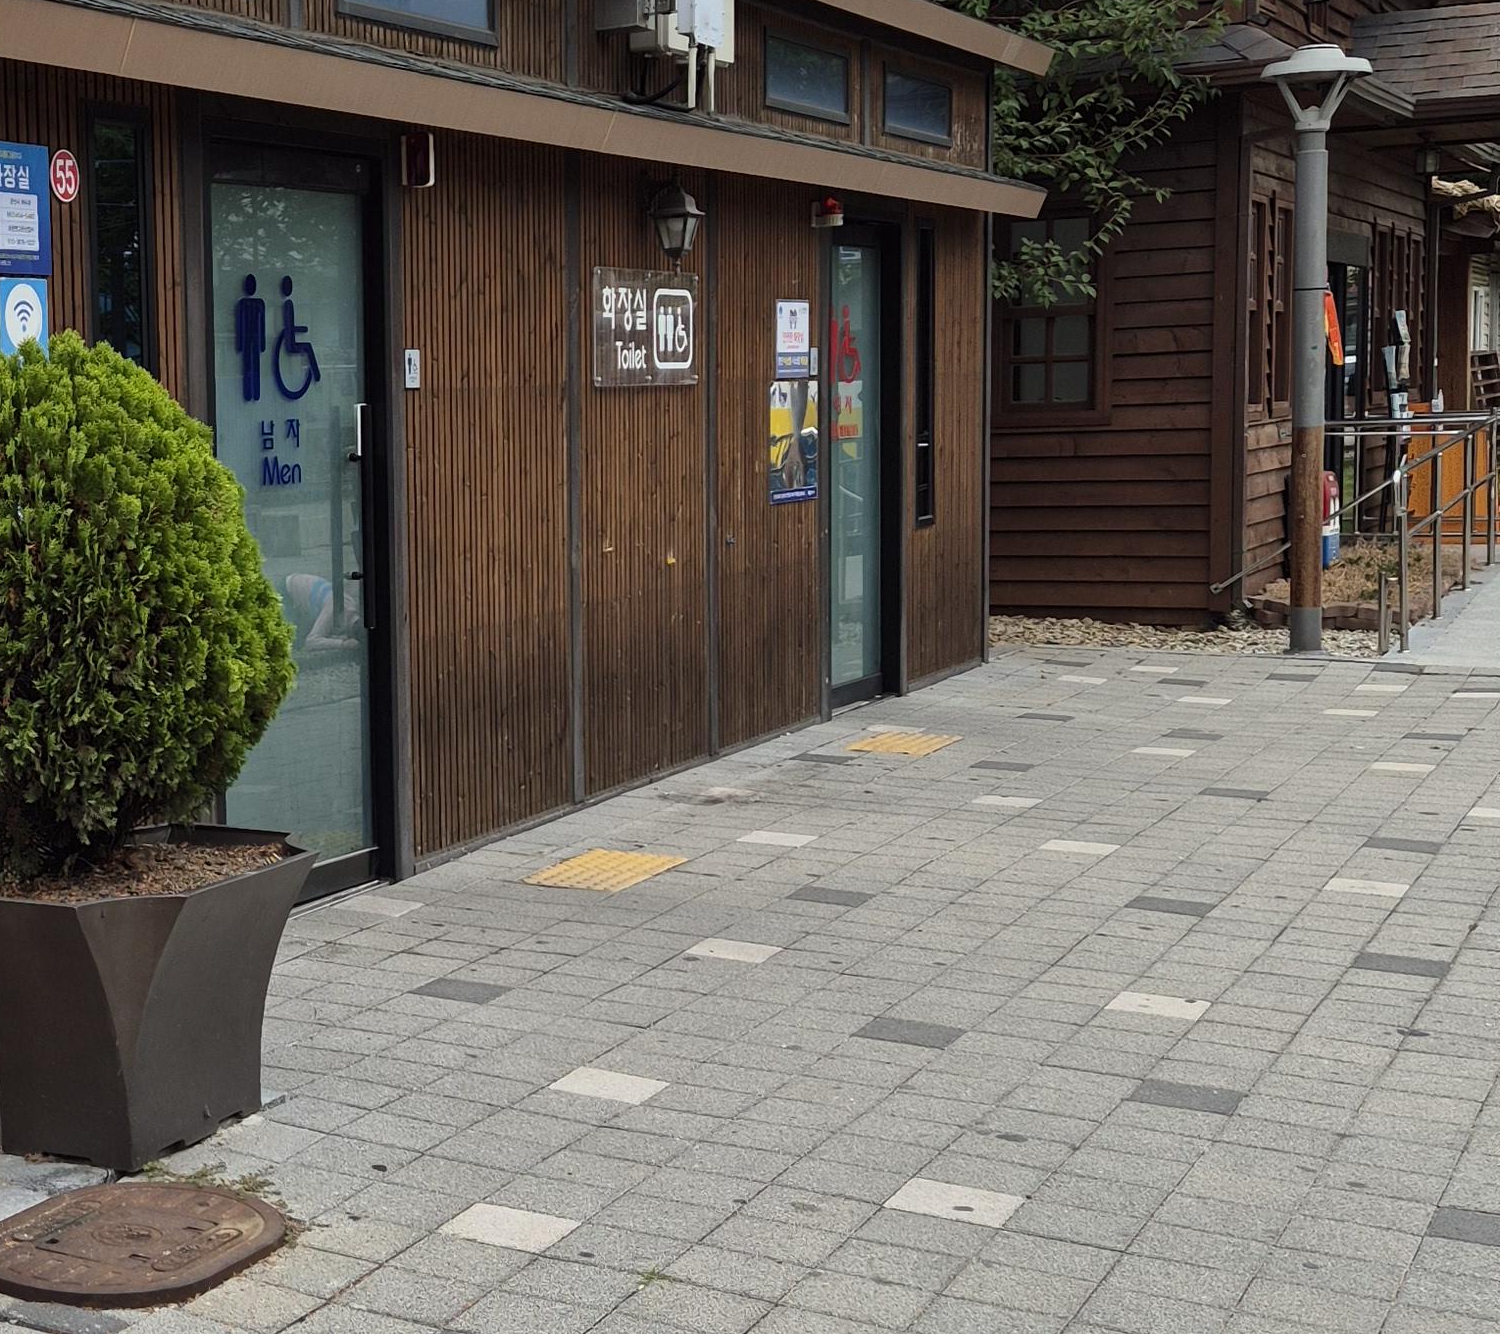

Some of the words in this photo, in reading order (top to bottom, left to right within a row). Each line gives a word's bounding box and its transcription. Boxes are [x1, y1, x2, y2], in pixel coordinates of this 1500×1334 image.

[56, 158, 76, 195] 55
[602, 285, 647, 332] 화장실
[615, 341, 647, 370] Toilet
[263, 455, 302, 486] Men
